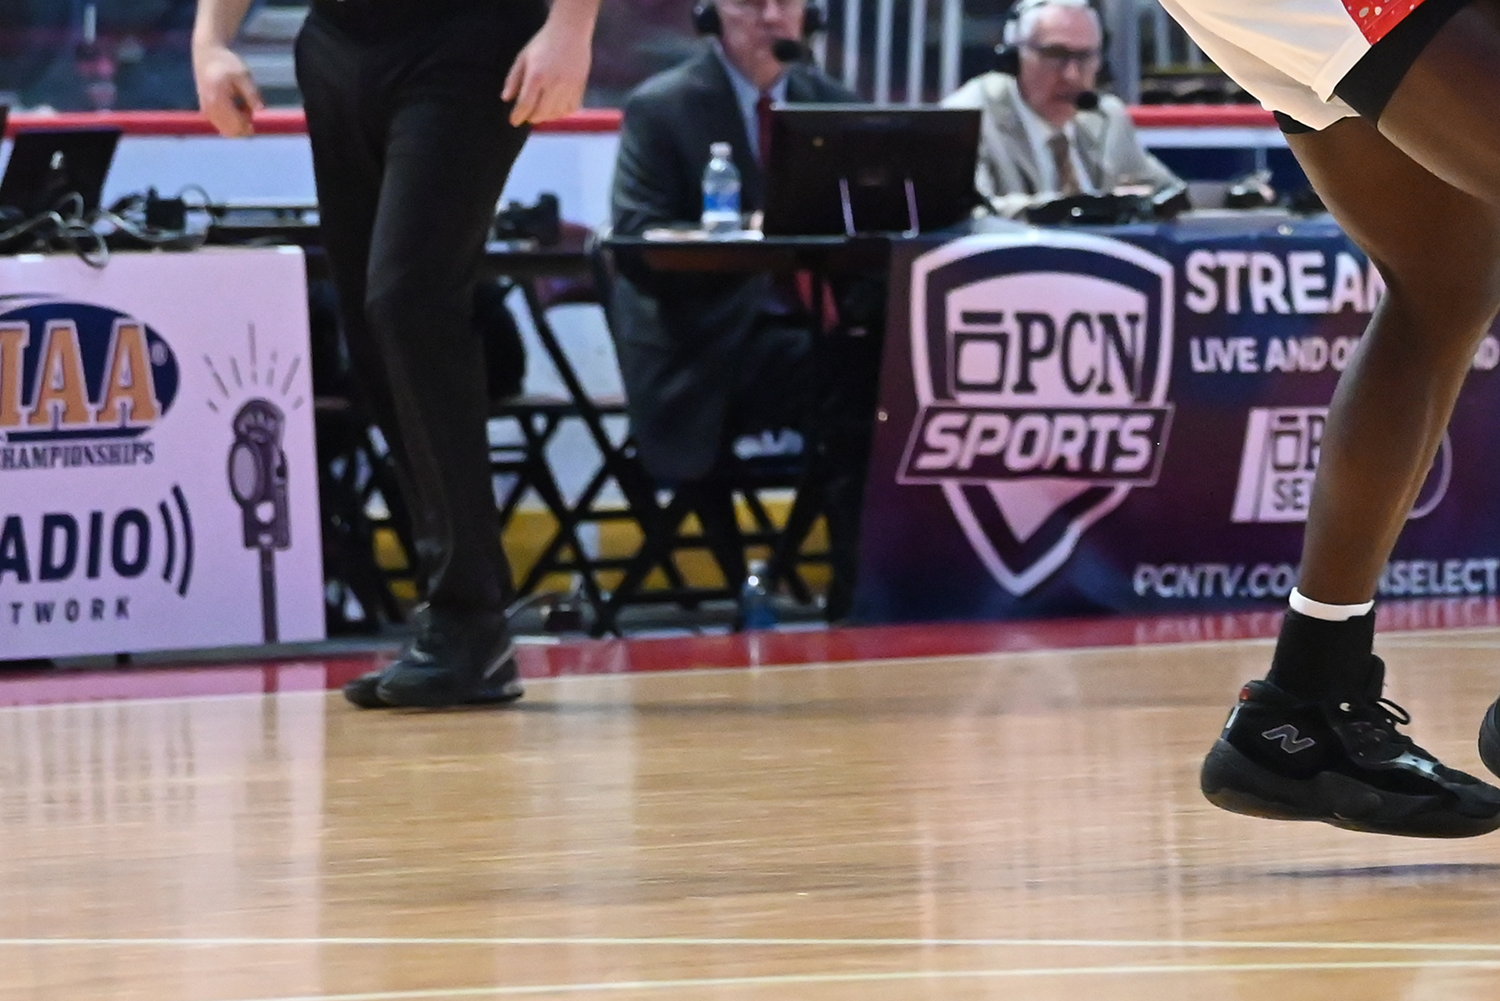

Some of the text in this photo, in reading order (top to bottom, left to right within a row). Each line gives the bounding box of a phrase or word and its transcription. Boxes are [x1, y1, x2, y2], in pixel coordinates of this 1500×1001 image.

[0, 320, 160, 430] IAA
[1012, 311, 1140, 396] PCN
[1190, 337, 1259, 373] LIVE
[1265, 337, 1327, 373] AND
[0, 441, 155, 471] HAMPIONSHIPS
[914, 412, 1155, 473] SPORTS
[0, 508, 151, 584] ADIO
[9, 597, 131, 626] TWORK
